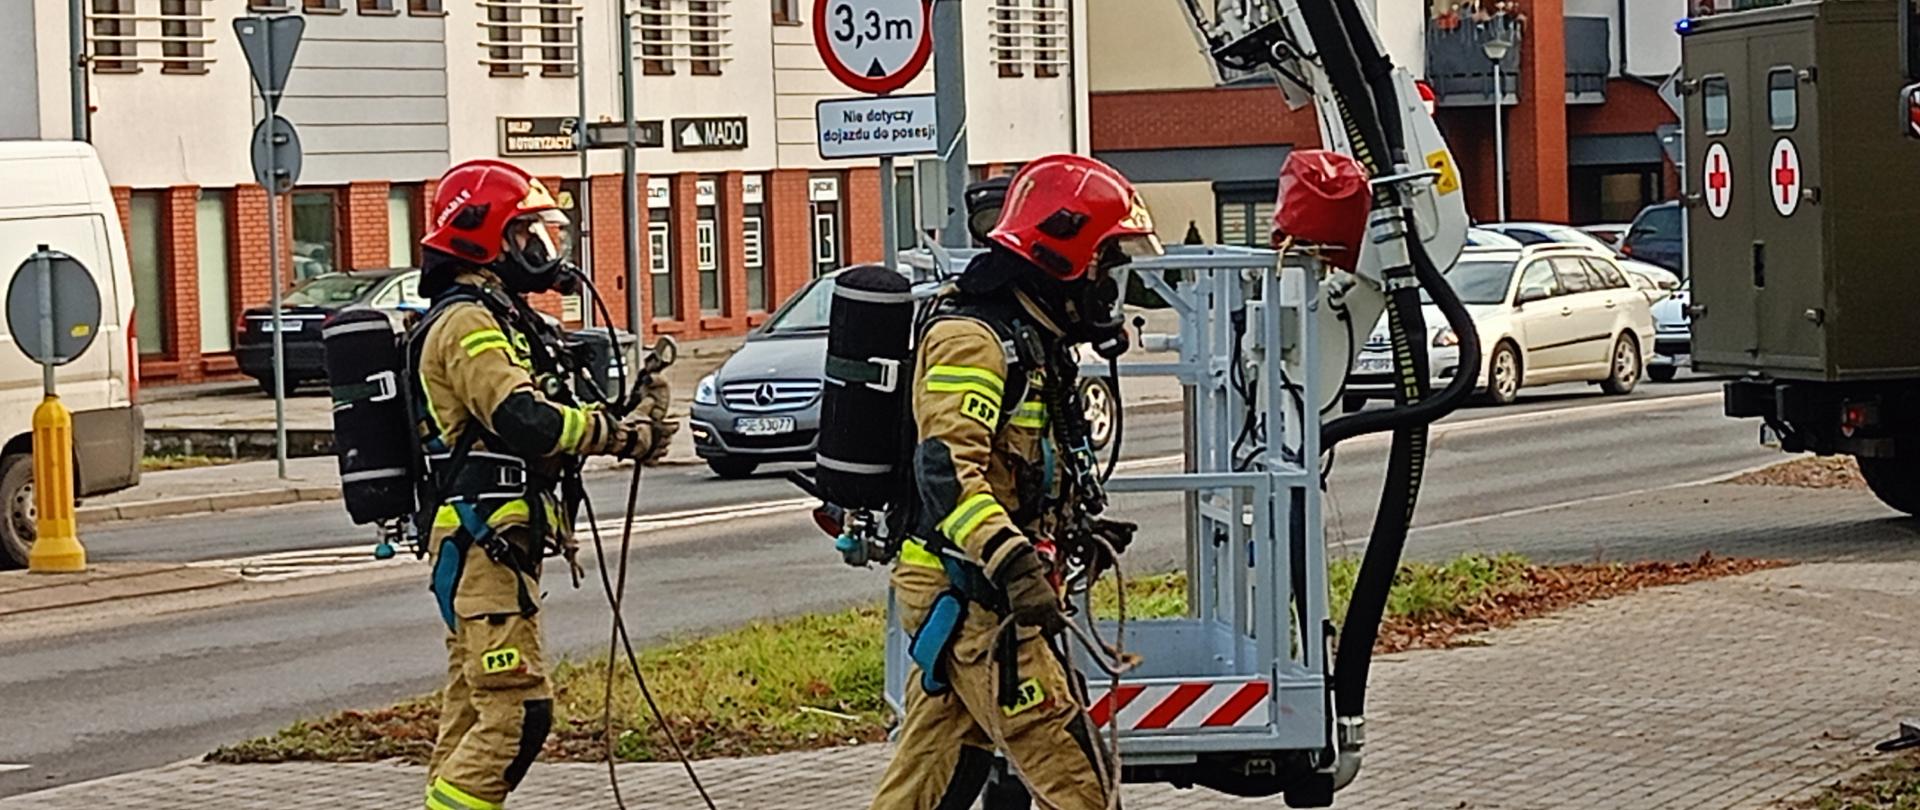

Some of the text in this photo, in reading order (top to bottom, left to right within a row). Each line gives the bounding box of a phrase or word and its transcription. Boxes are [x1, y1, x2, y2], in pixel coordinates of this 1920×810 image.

[834, 4, 913, 49] 3,3m
[843, 109, 913, 125] Nie dotyczy
[704, 121, 744, 146] MADO
[823, 124, 935, 144] dojazdu do posesji
[967, 397, 995, 422] PSP
[486, 652, 514, 669] PSP
[1009, 685, 1036, 711] SP
